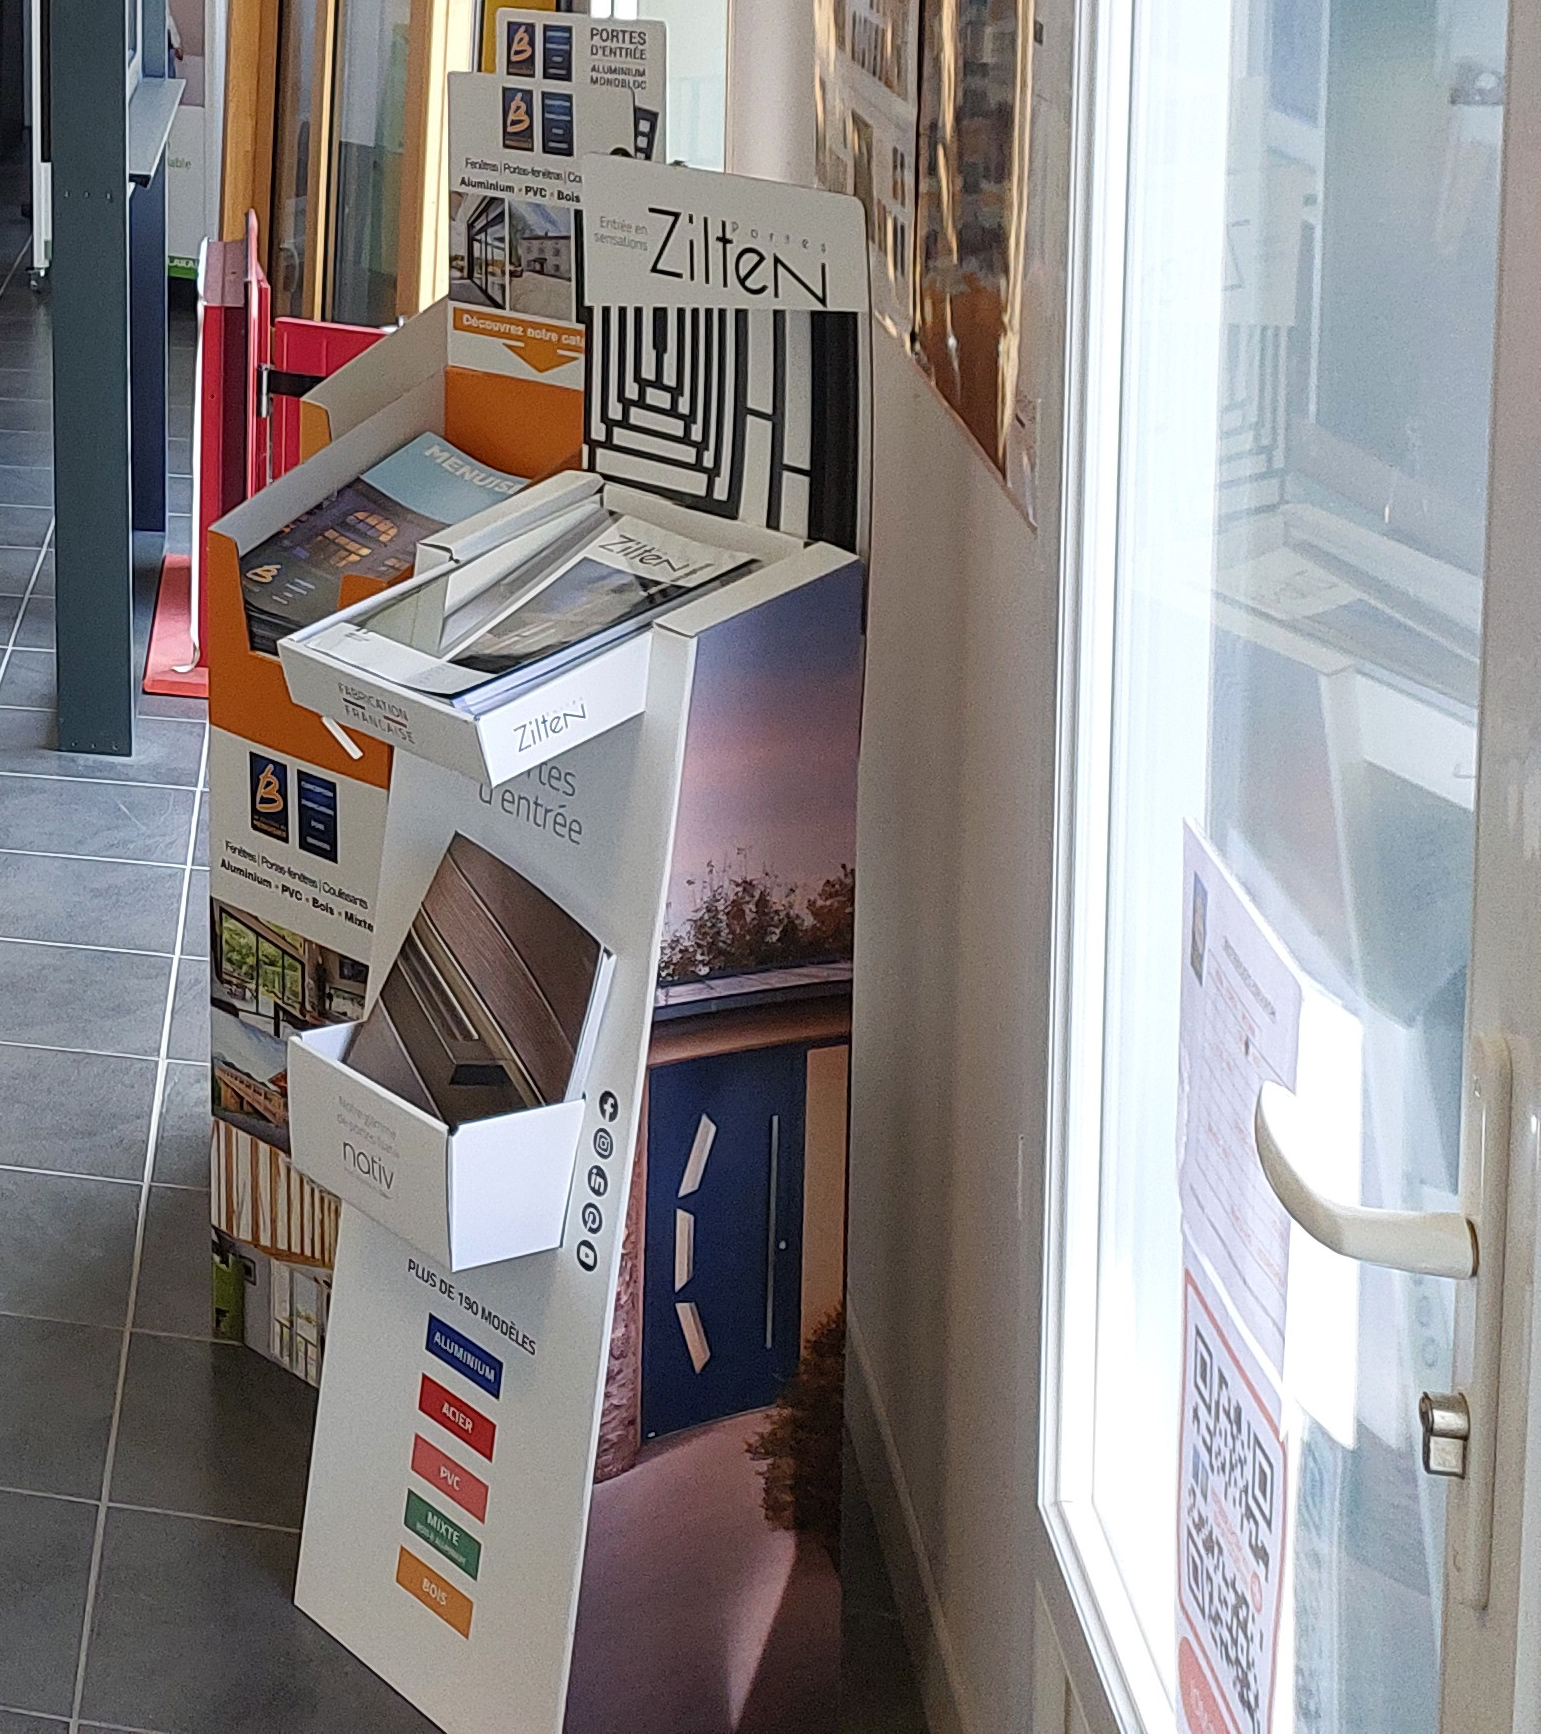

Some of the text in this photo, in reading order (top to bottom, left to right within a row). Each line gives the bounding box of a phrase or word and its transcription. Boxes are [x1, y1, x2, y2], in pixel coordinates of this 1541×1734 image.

[590, 27, 647, 46] PORTES
[590, 44, 647, 60] D'ENTRÉE
[590, 64, 646, 78] ALUMINIUM
[590, 76, 647, 90] MONOBLOC
[459, 176, 581, 204] Aluminium PVC Bois
[599, 216, 647, 236] Entrée en
[594, 232, 648, 251] sensations
[463, 314, 525, 336] Découvrez
[527, 327, 558, 342] notre
[337, 682, 409, 722] FABRICATION
[220, 858, 374, 933] Aluminium PVC Bois Mixte
[343, 1142, 394, 1190] nativ
[407, 1258, 536, 1356] PLUS DE 190 MODÈLES
[433, 1331, 495, 1383] ALUMINIUM
[441, 1402, 473, 1434] ACIER
[439, 1466, 461, 1491] PVC
[427, 1511, 460, 1546] MIXTE
[421, 1577, 447, 1606] BOIS
